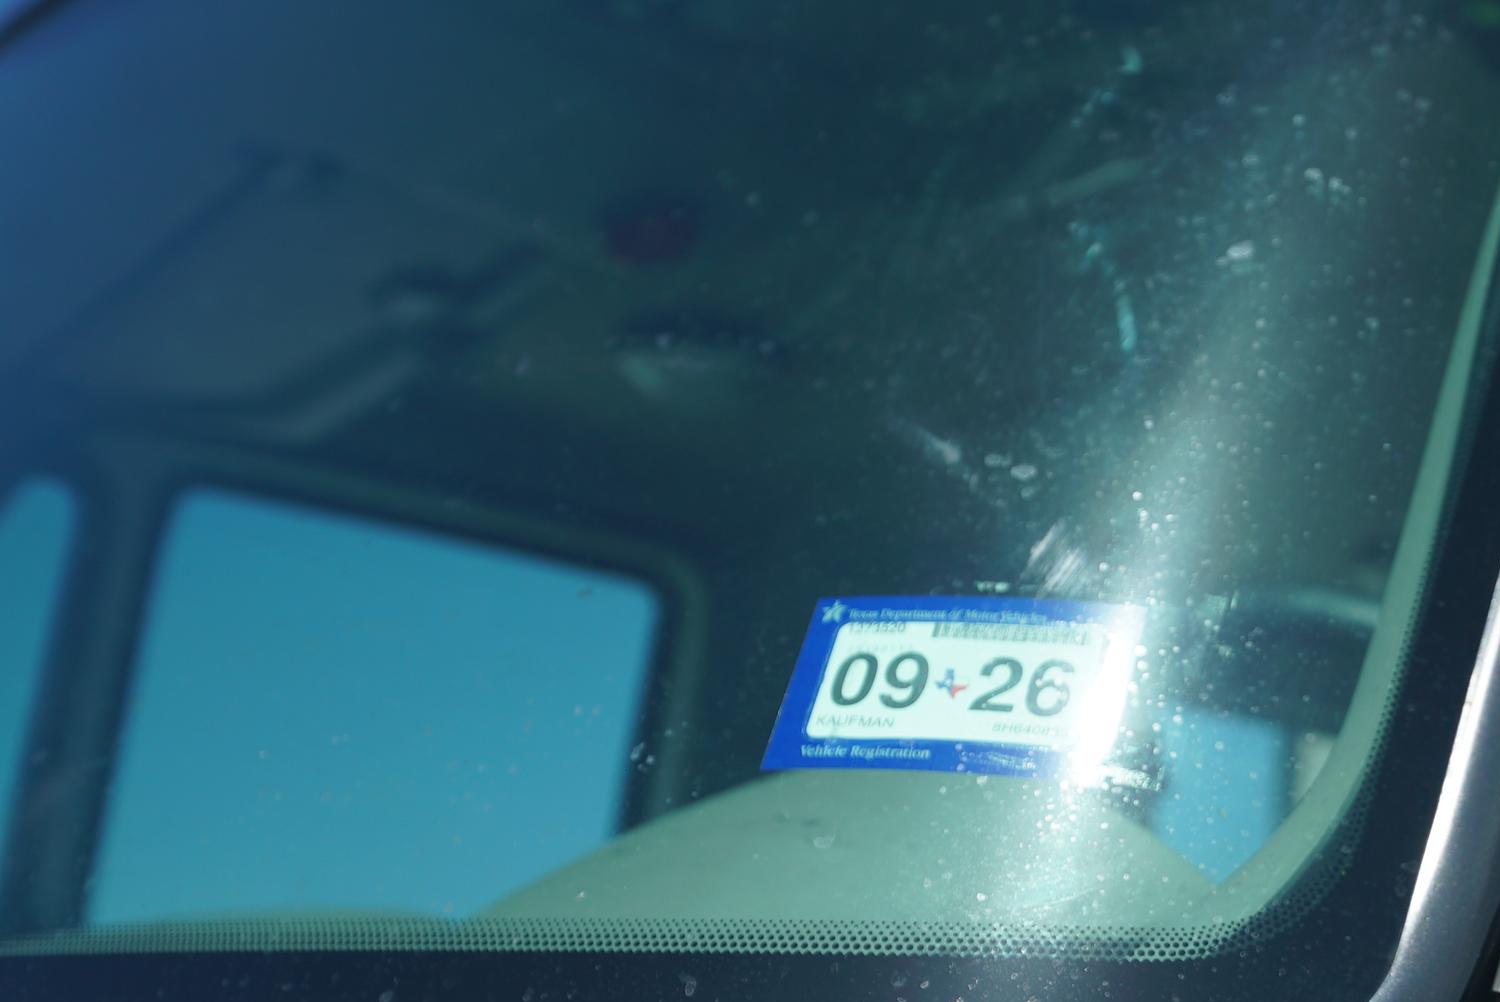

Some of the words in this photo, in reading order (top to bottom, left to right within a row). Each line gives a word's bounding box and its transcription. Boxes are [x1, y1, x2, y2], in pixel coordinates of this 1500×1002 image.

[849, 608, 877, 619] Texas
[881, 608, 945, 620] Department
[949, 608, 962, 620] of
[965, 609, 999, 621] Motor
[830, 651, 929, 709] 09
[969, 656, 1075, 717] 26
[816, 715, 895, 728] KAUFMAN
[800, 744, 847, 759] Vehicle
[851, 745, 931, 760] Registration
